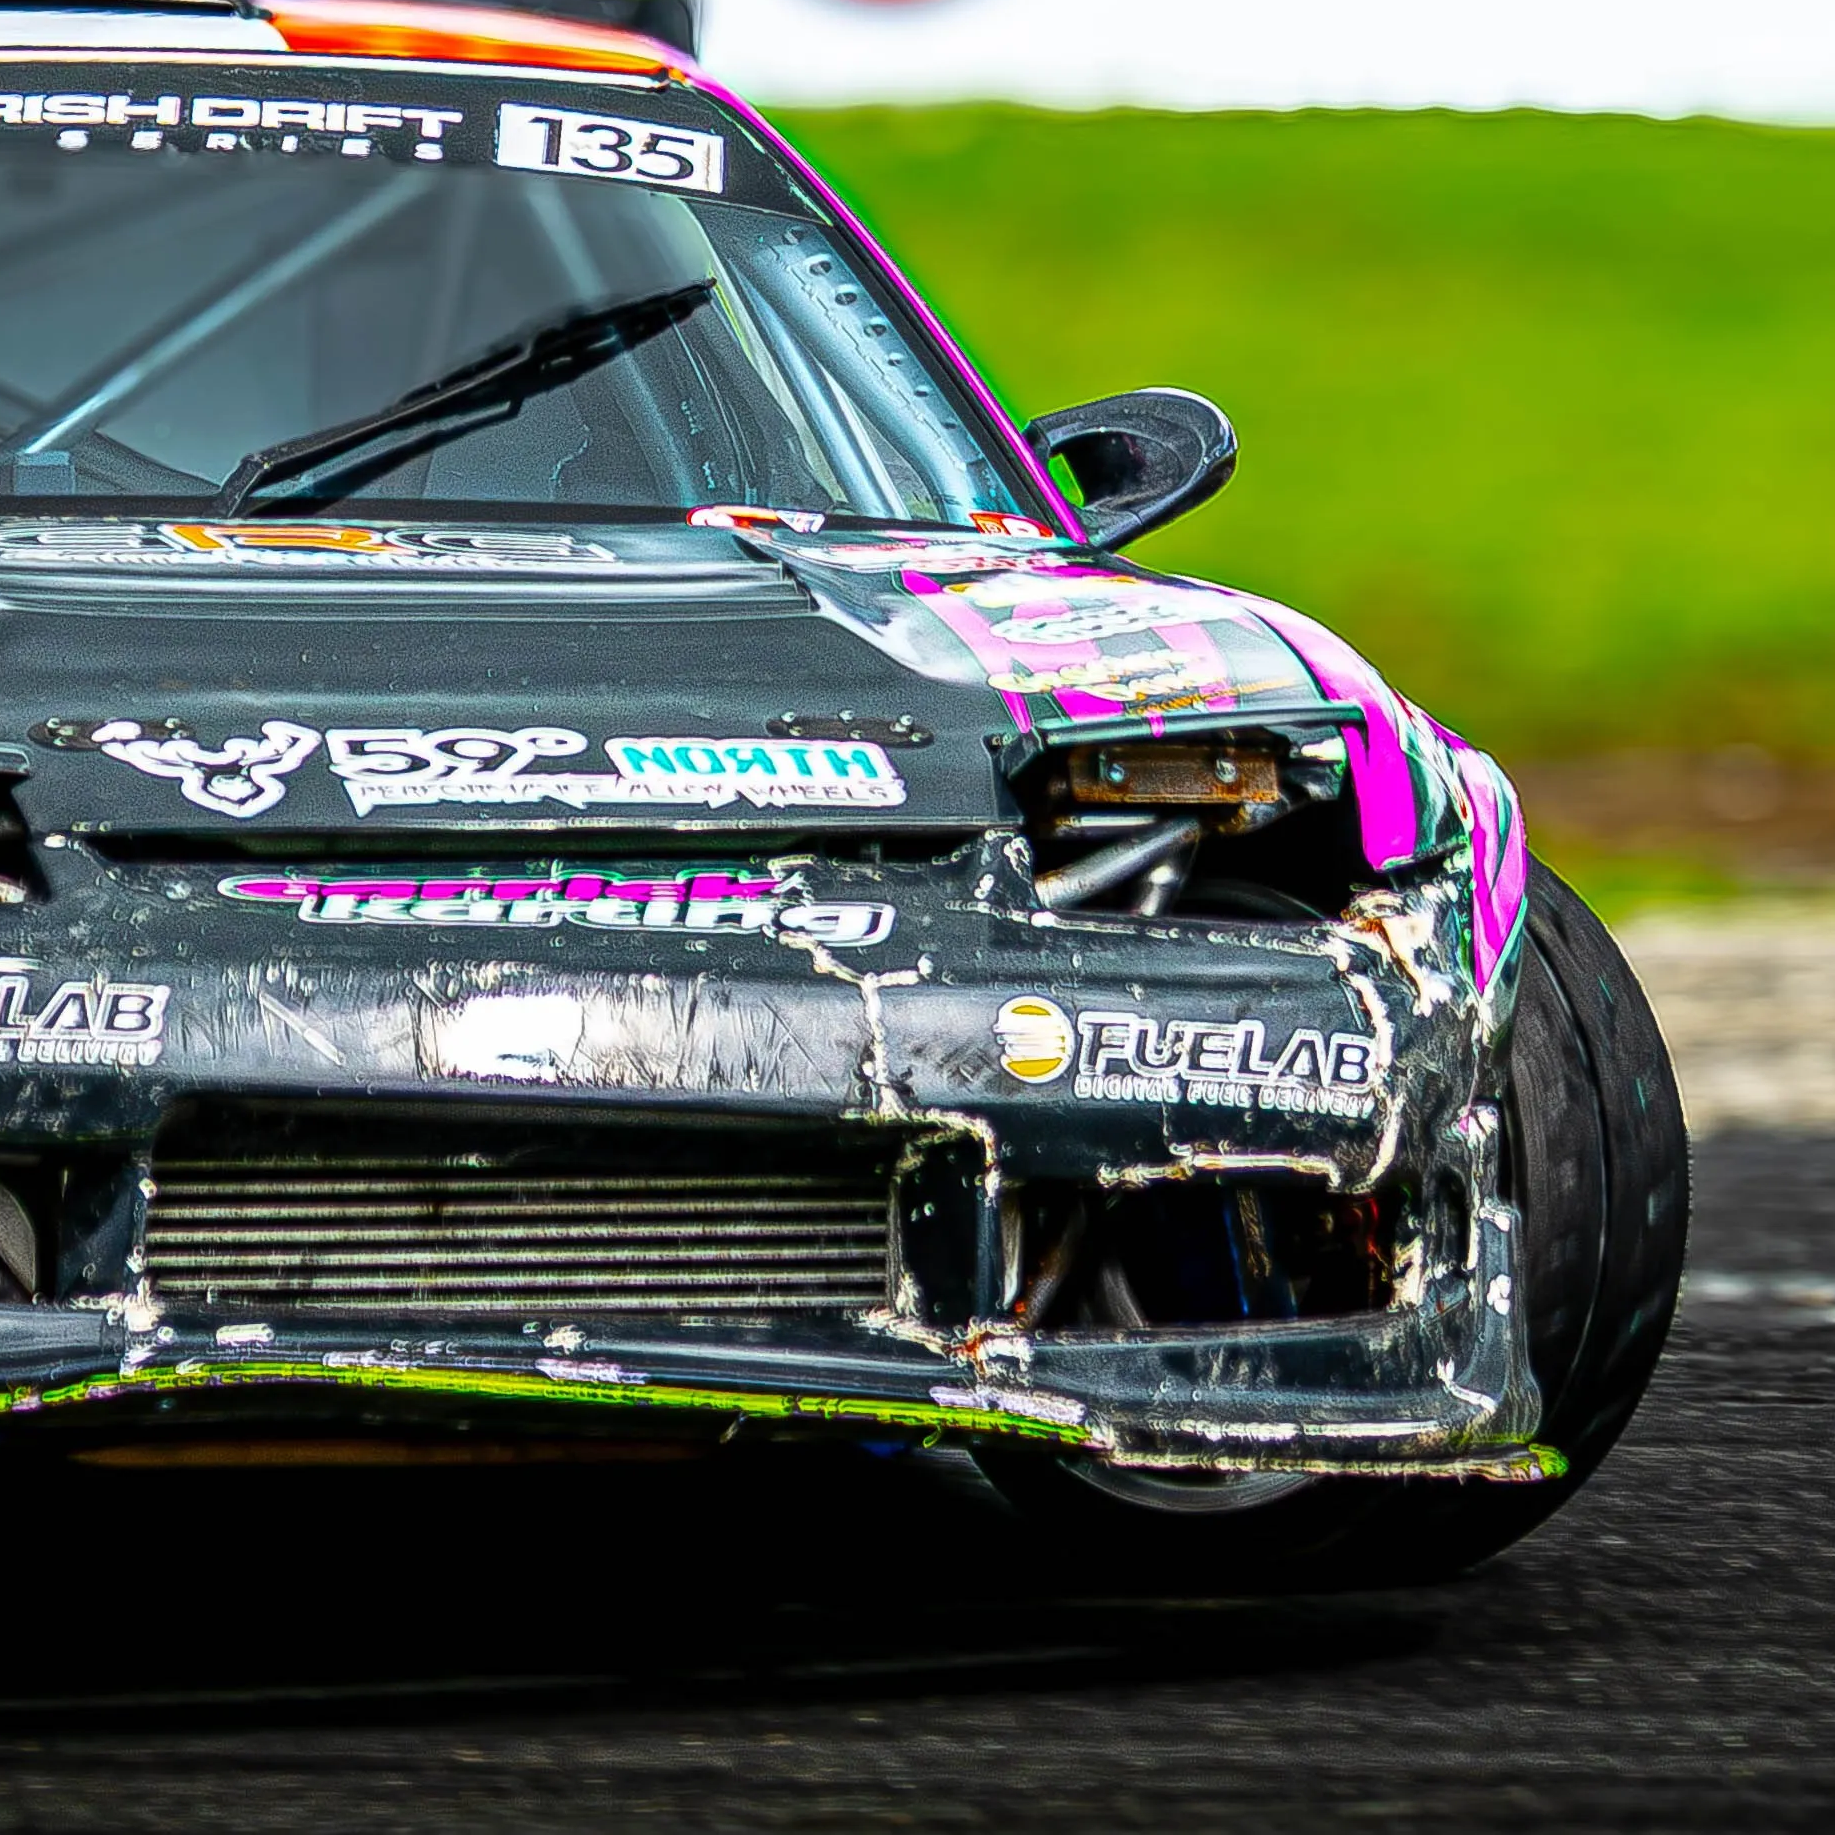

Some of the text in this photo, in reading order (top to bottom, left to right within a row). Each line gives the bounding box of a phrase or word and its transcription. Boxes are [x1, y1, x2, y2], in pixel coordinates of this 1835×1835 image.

[190, 94, 464, 140] DRIFT
[55, 127, 444, 162] SERIES
[523, 114, 699, 183] 135
[15, 1041, 163, 1067] DELIVERY
[1075, 1010, 1378, 1093] FUELAB
[1074, 1073, 1179, 1104] DIGITAL
[1188, 1079, 1255, 1107] FUEL
